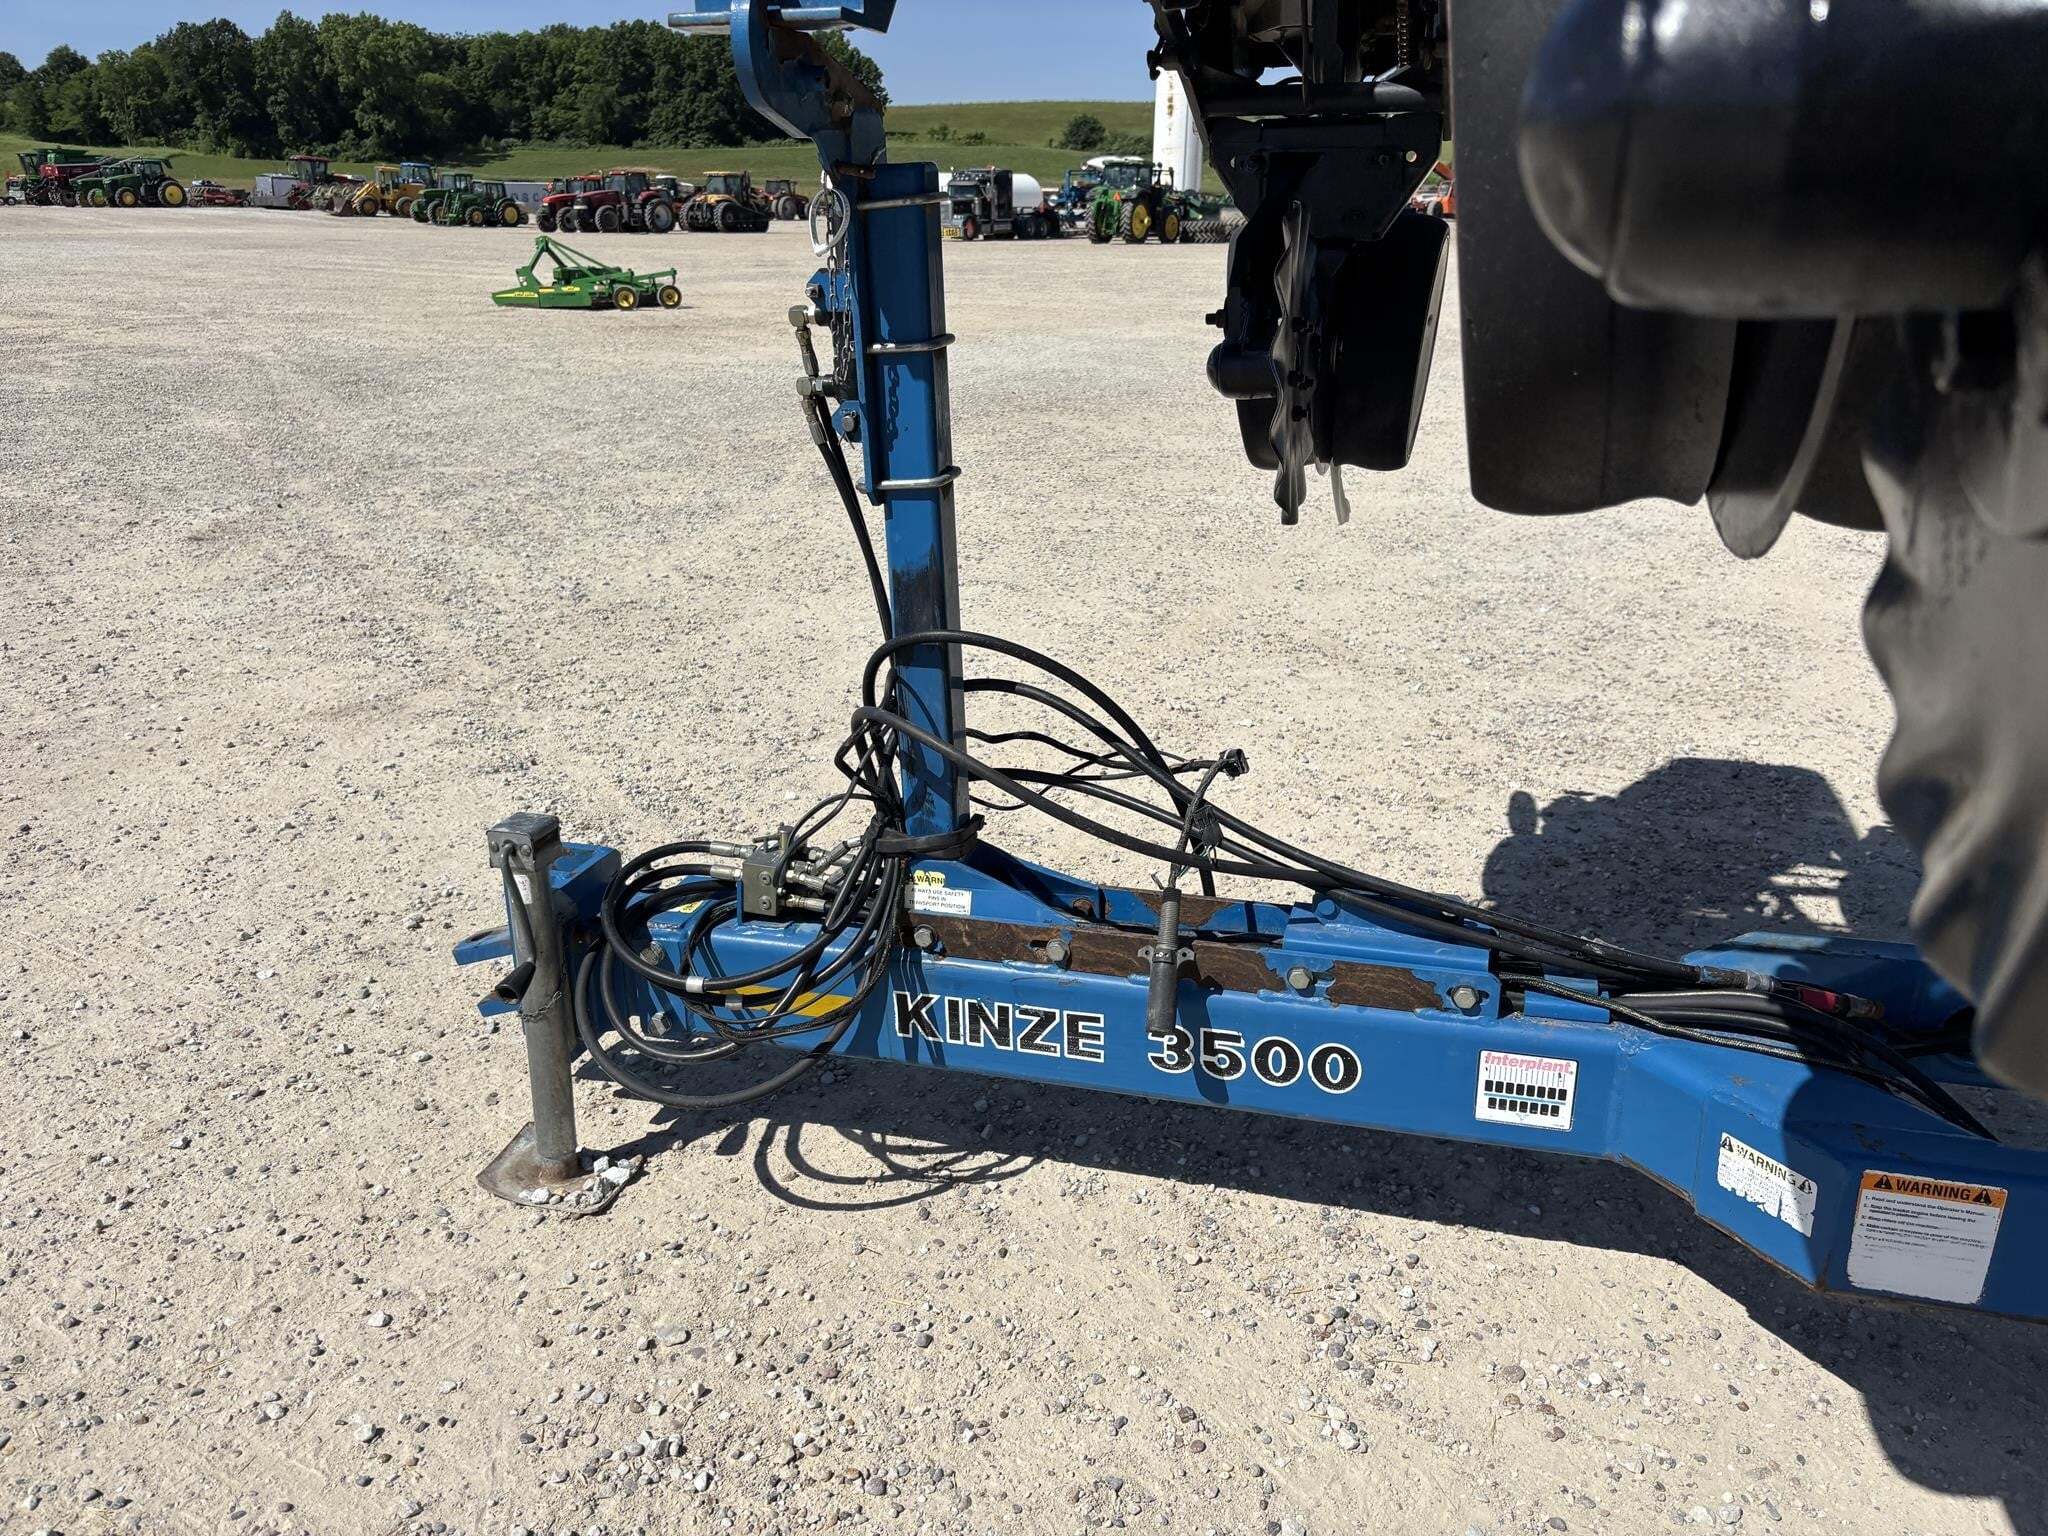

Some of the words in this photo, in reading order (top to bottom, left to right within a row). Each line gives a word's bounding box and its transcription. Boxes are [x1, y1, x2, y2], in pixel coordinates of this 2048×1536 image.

[893, 991, 1105, 1063] KINZE
[1147, 1026, 1362, 1094] 3500
[1736, 1144, 1797, 1186] WARNING
[1896, 1178, 1971, 1200] WARNING
